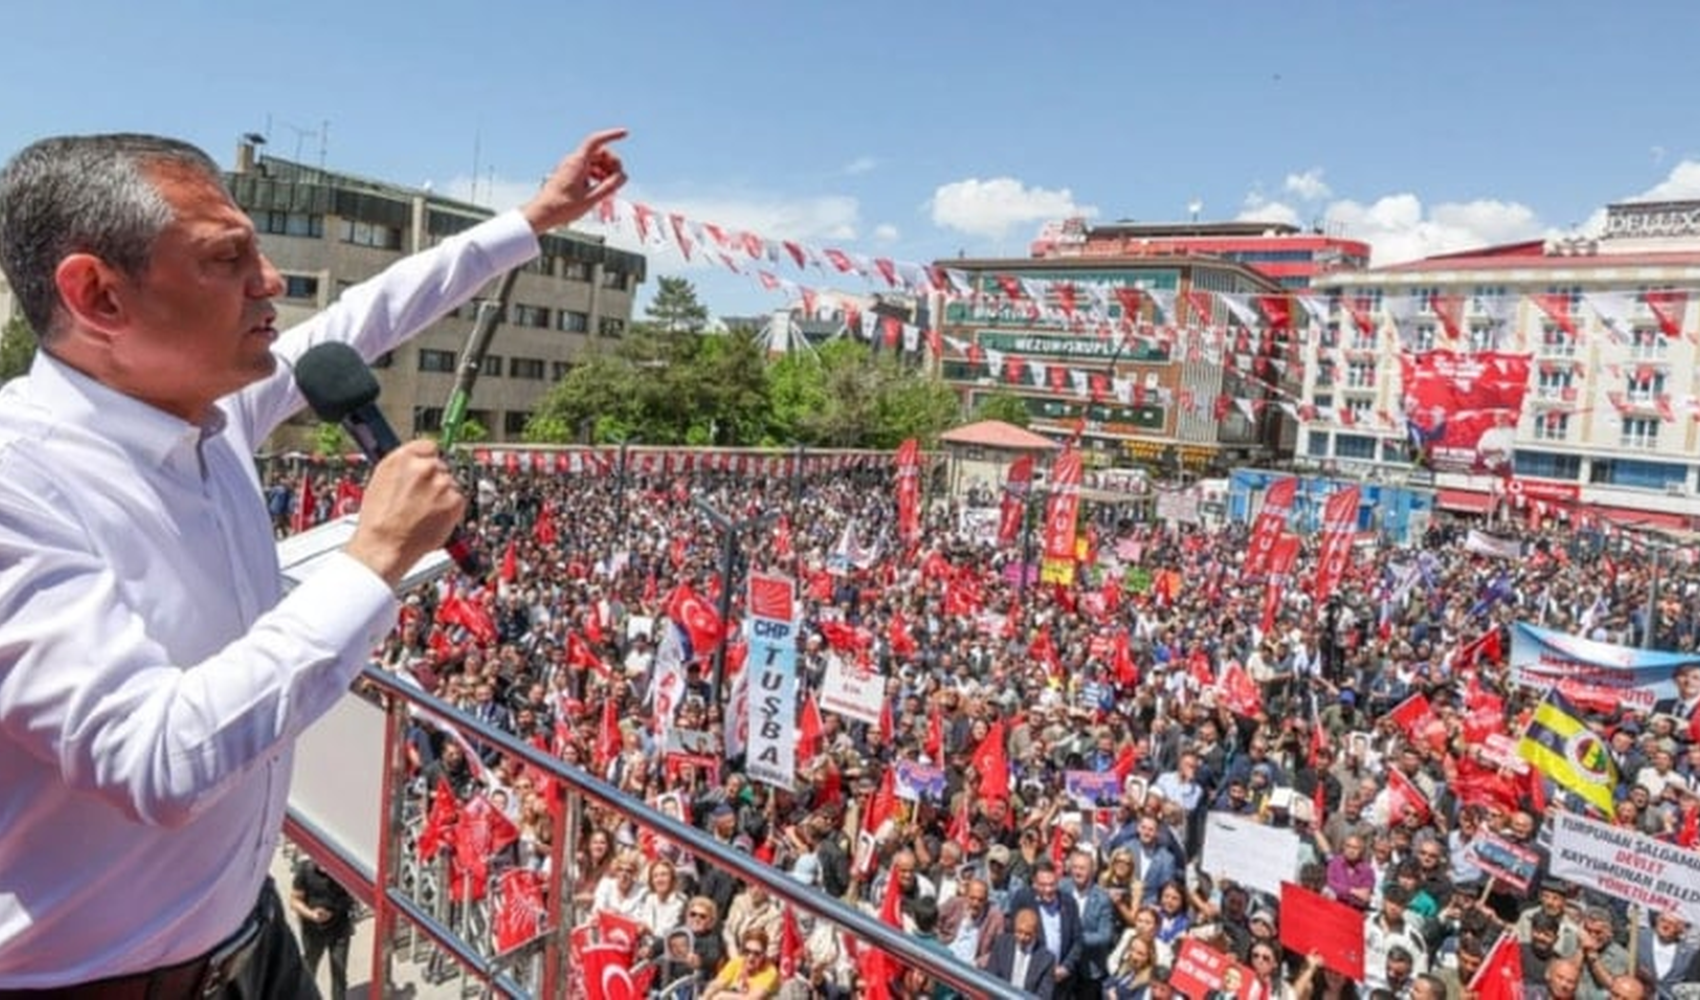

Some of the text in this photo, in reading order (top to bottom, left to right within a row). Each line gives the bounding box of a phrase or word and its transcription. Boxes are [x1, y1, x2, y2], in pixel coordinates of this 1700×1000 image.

[753, 620, 790, 640] CHP
[758, 645, 783, 766] TUŞBA
[1614, 849, 1666, 876] DEVLET
